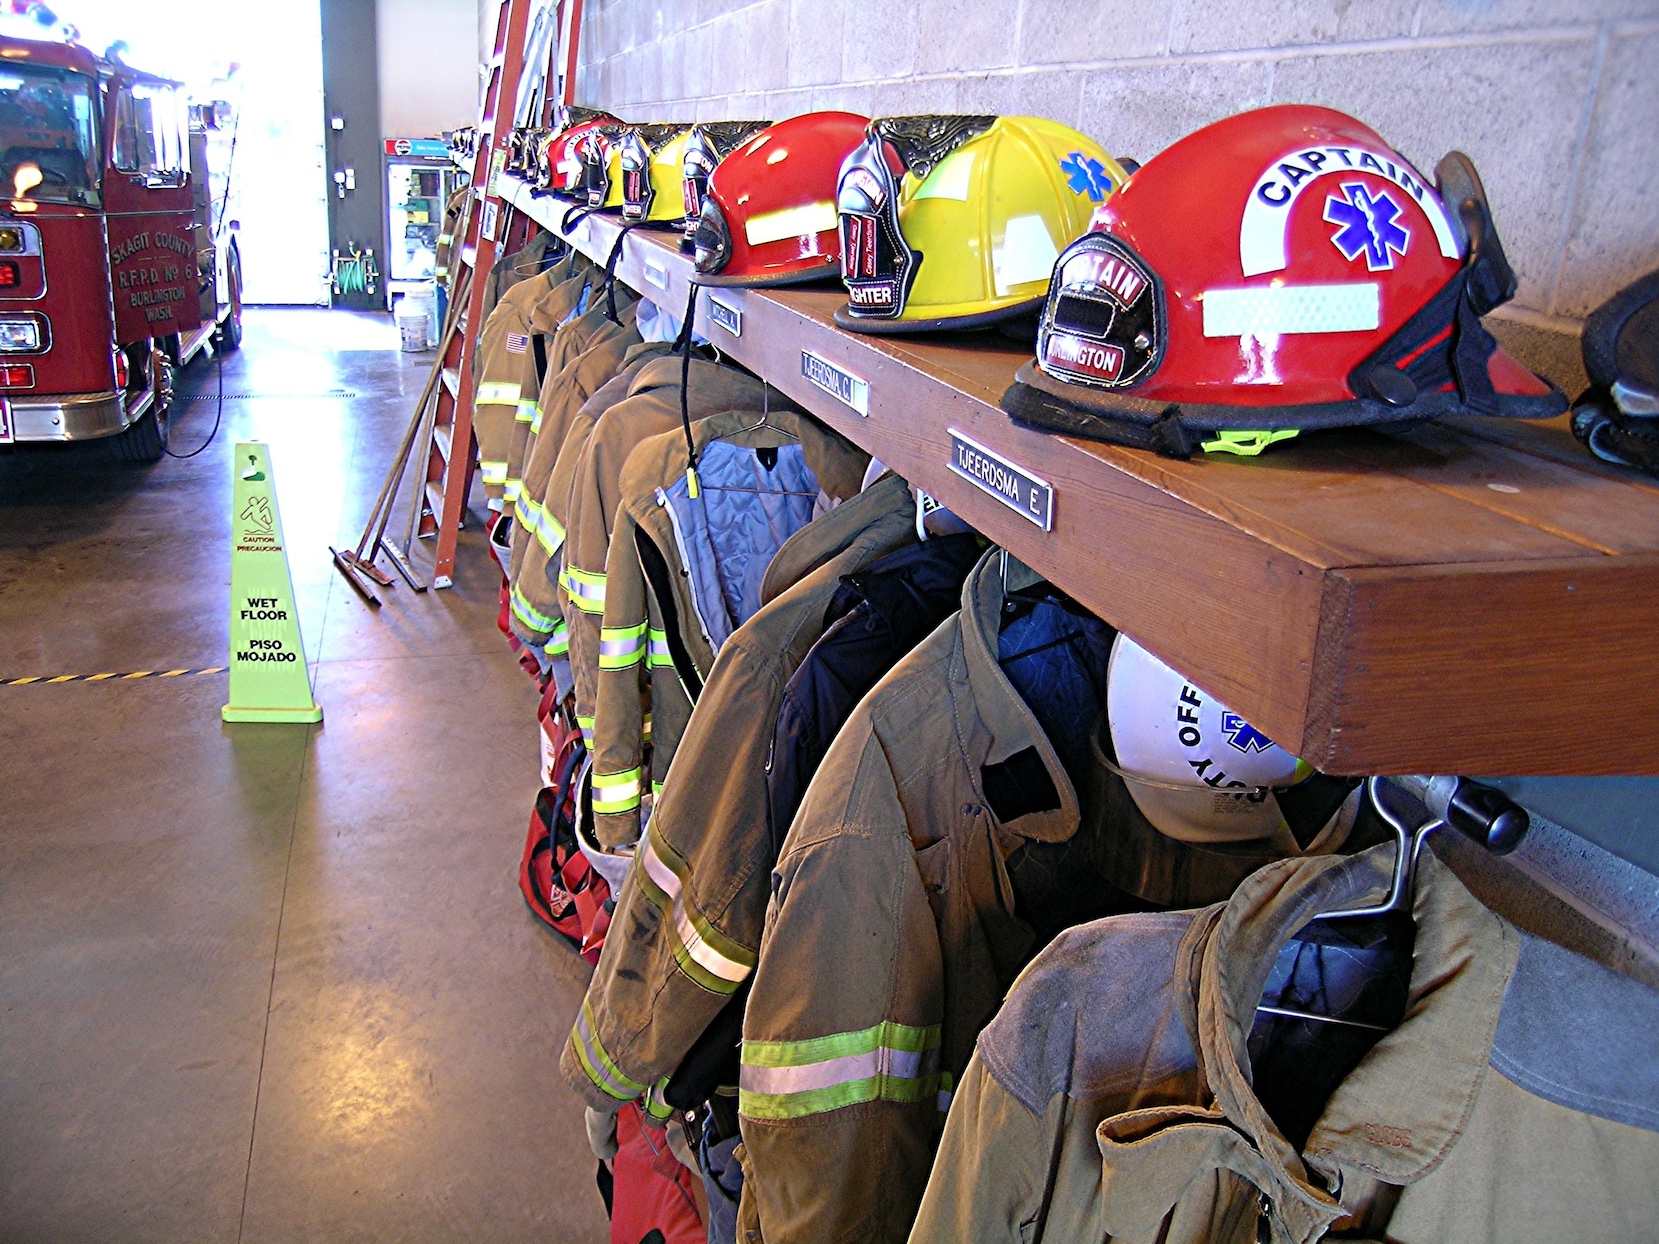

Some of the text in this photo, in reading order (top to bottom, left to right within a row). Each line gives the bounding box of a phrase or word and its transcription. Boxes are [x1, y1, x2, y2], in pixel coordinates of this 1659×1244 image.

[1257, 147, 1425, 208] CAPTAIN
[111, 232, 194, 265] SKAGIT COUNTY
[185, 264, 193, 281] 6
[1074, 253, 1140, 301] TAIN
[130, 286, 186, 307] BURLINGTON
[957, 443, 1020, 502] TJEERDSMA
[247, 598, 278, 608] WET
[240, 610, 288, 621] FLOOR
[249, 640, 283, 650] PISO
[236, 652, 297, 663] MOJADO
